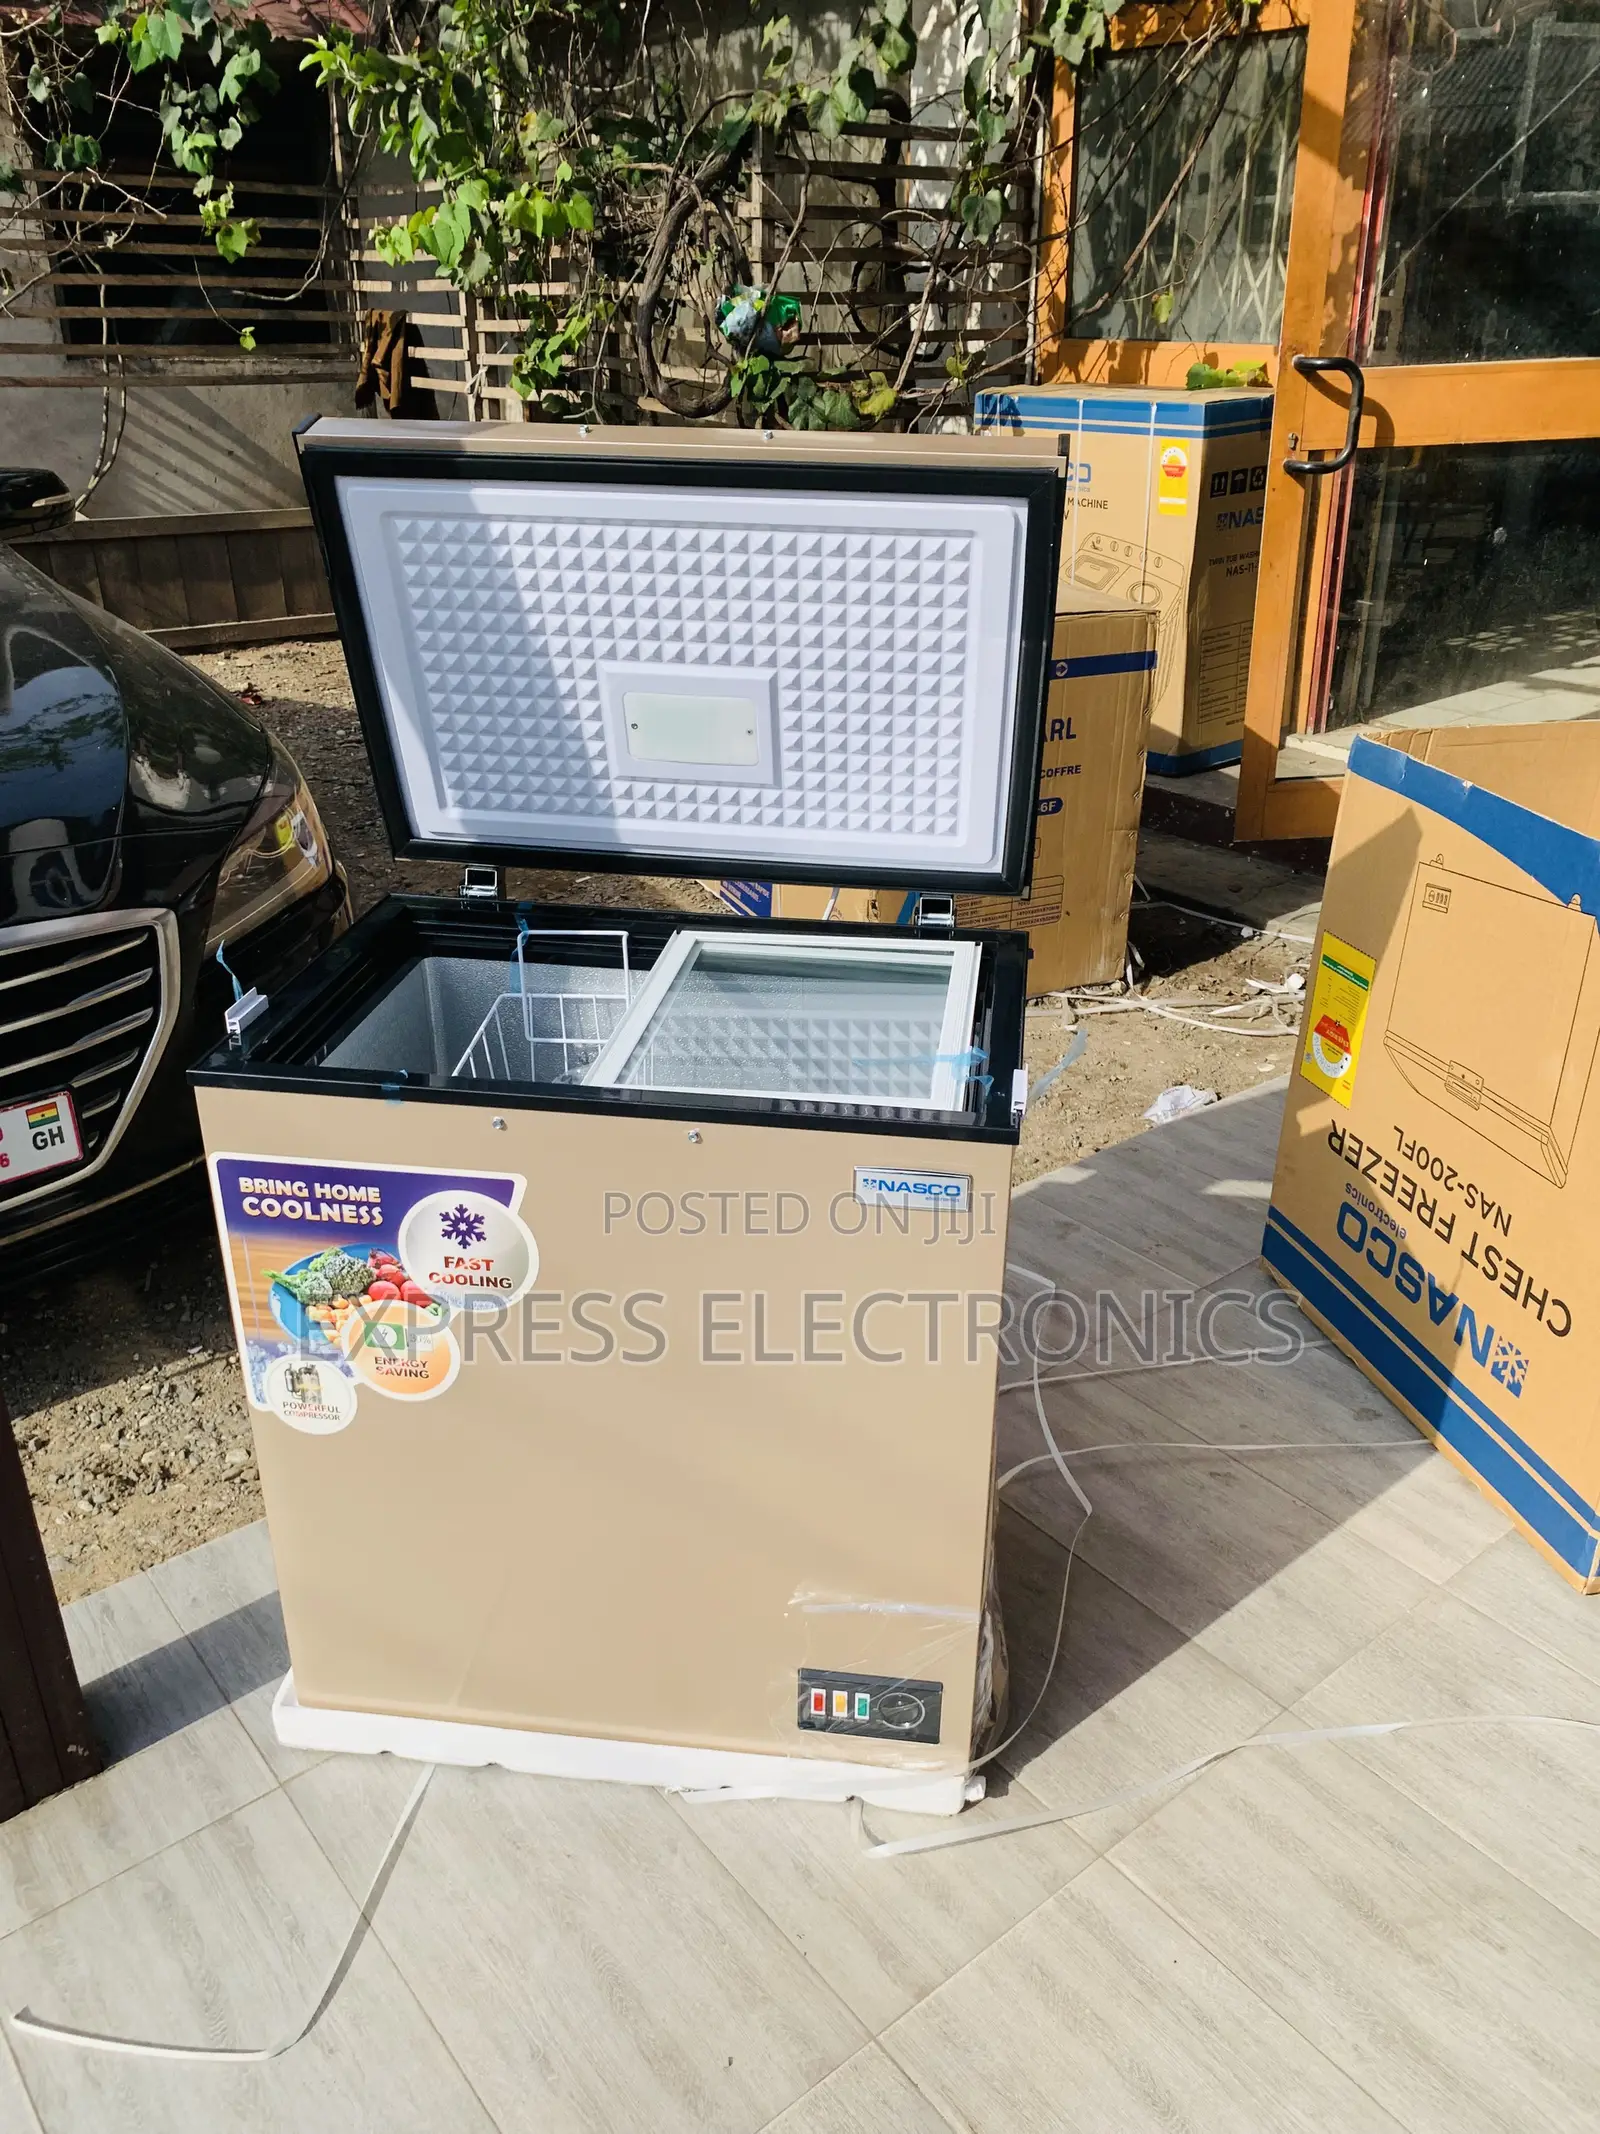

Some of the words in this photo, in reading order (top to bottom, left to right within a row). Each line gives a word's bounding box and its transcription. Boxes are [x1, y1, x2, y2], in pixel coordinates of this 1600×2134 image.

[1229, 507, 1264, 529] NAS
[1045, 716, 1077, 742] RL
[1040, 764, 1082, 779] COFFRE
[31, 1125, 66, 1151] GH
[237, 1176, 309, 1199] BRING
[314, 1182, 382, 1203] HOME
[877, 1179, 961, 1197] NASCO
[1327, 1118, 1456, 1245] FREEZER
[1393, 1125, 1513, 1237] NAS-200FL
[242, 1196, 384, 1227] COOLNESS
[1344, 1182, 1408, 1241] electronics
[443, 1255, 495, 1273] FAST
[428, 1271, 513, 1290] COOLING
[1336, 1201, 1495, 1369] NASCO
[1461, 1231, 1572, 1338] CHEST
[374, 1356, 429, 1370] ENERGY
[375, 1365, 430, 1381] SAVING
[282, 1401, 342, 1414] POWERFUL
[283, 1409, 342, 1422] COMPRESSOR
